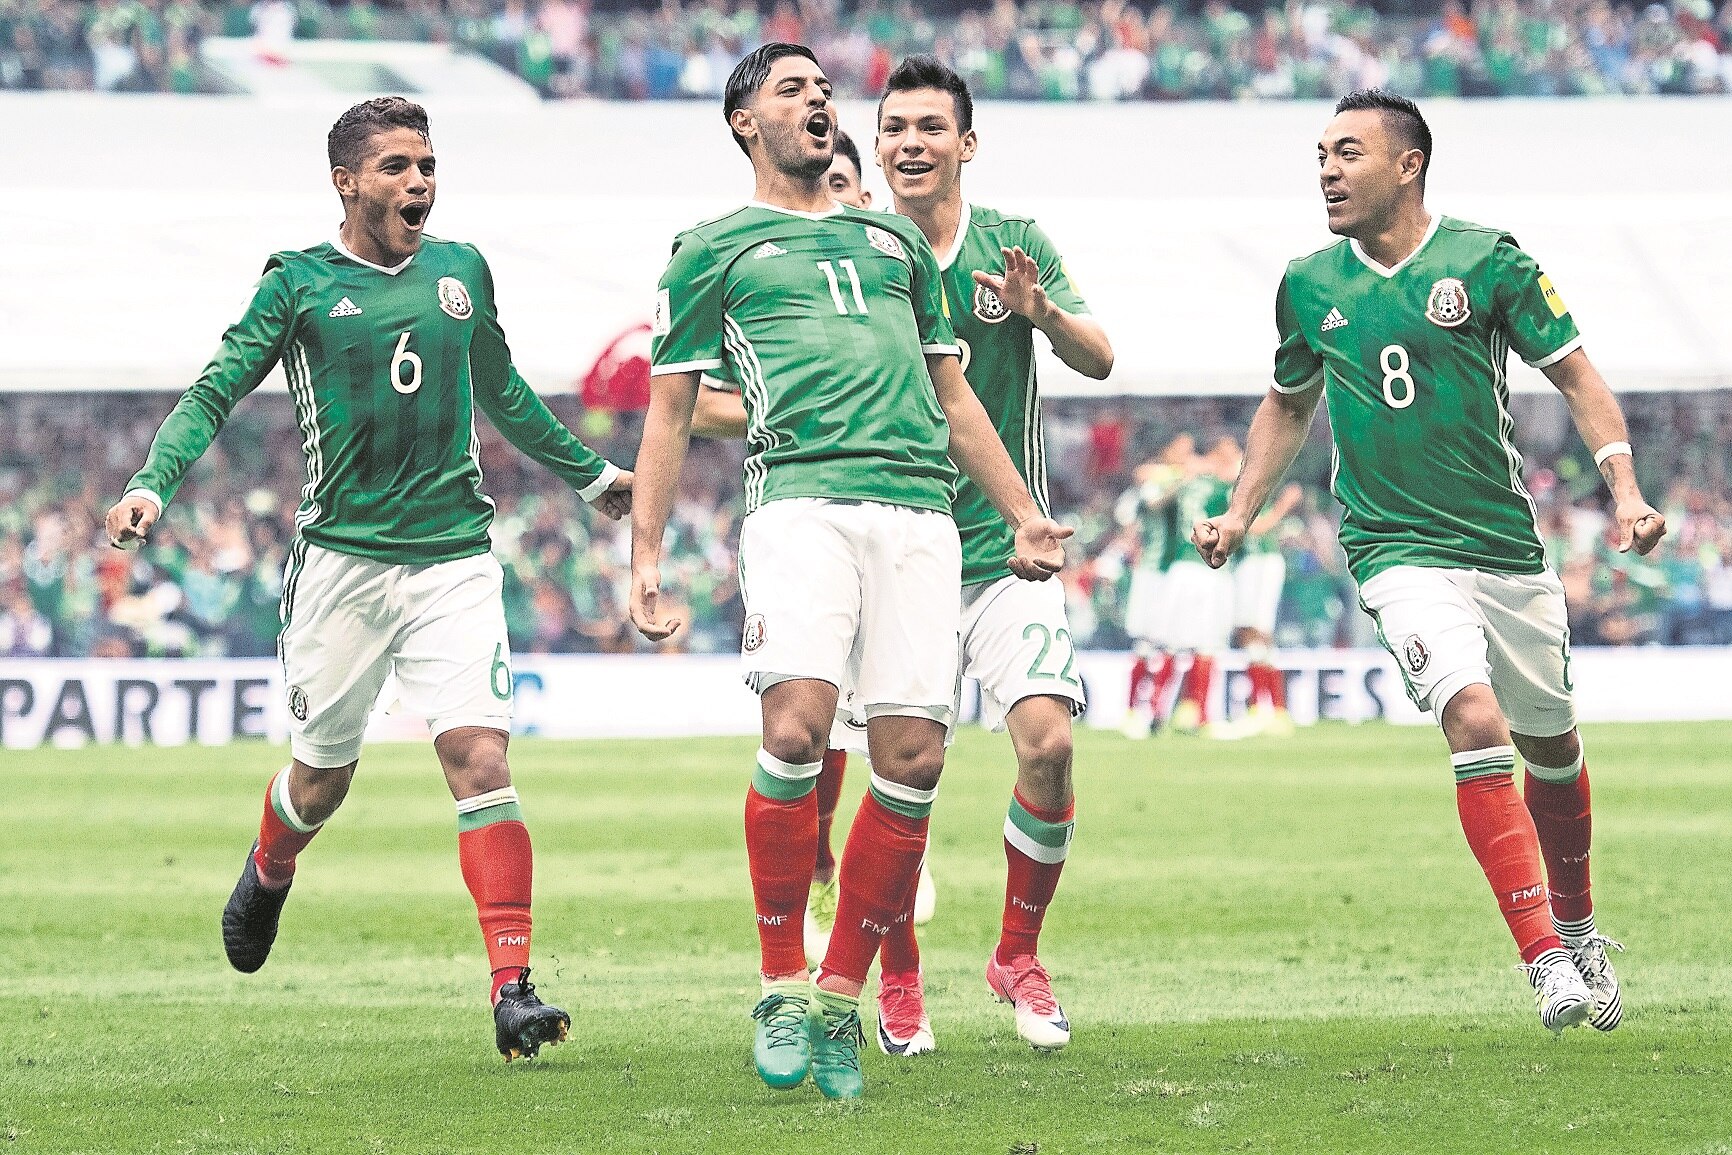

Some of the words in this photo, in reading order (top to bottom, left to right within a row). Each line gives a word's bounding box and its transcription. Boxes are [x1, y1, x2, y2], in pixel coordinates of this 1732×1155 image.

[328, 307, 364, 318] adidas
[816, 258, 869, 315] 11
[1321, 318, 1349, 332] adidas
[390, 331, 423, 394] 6
[1379, 344, 1416, 409] 8
[490, 641, 512, 701] 6
[1022, 622, 1078, 687] 22
[0, 678, 269, 742] PARTE
[756, 913, 788, 926] FMF
